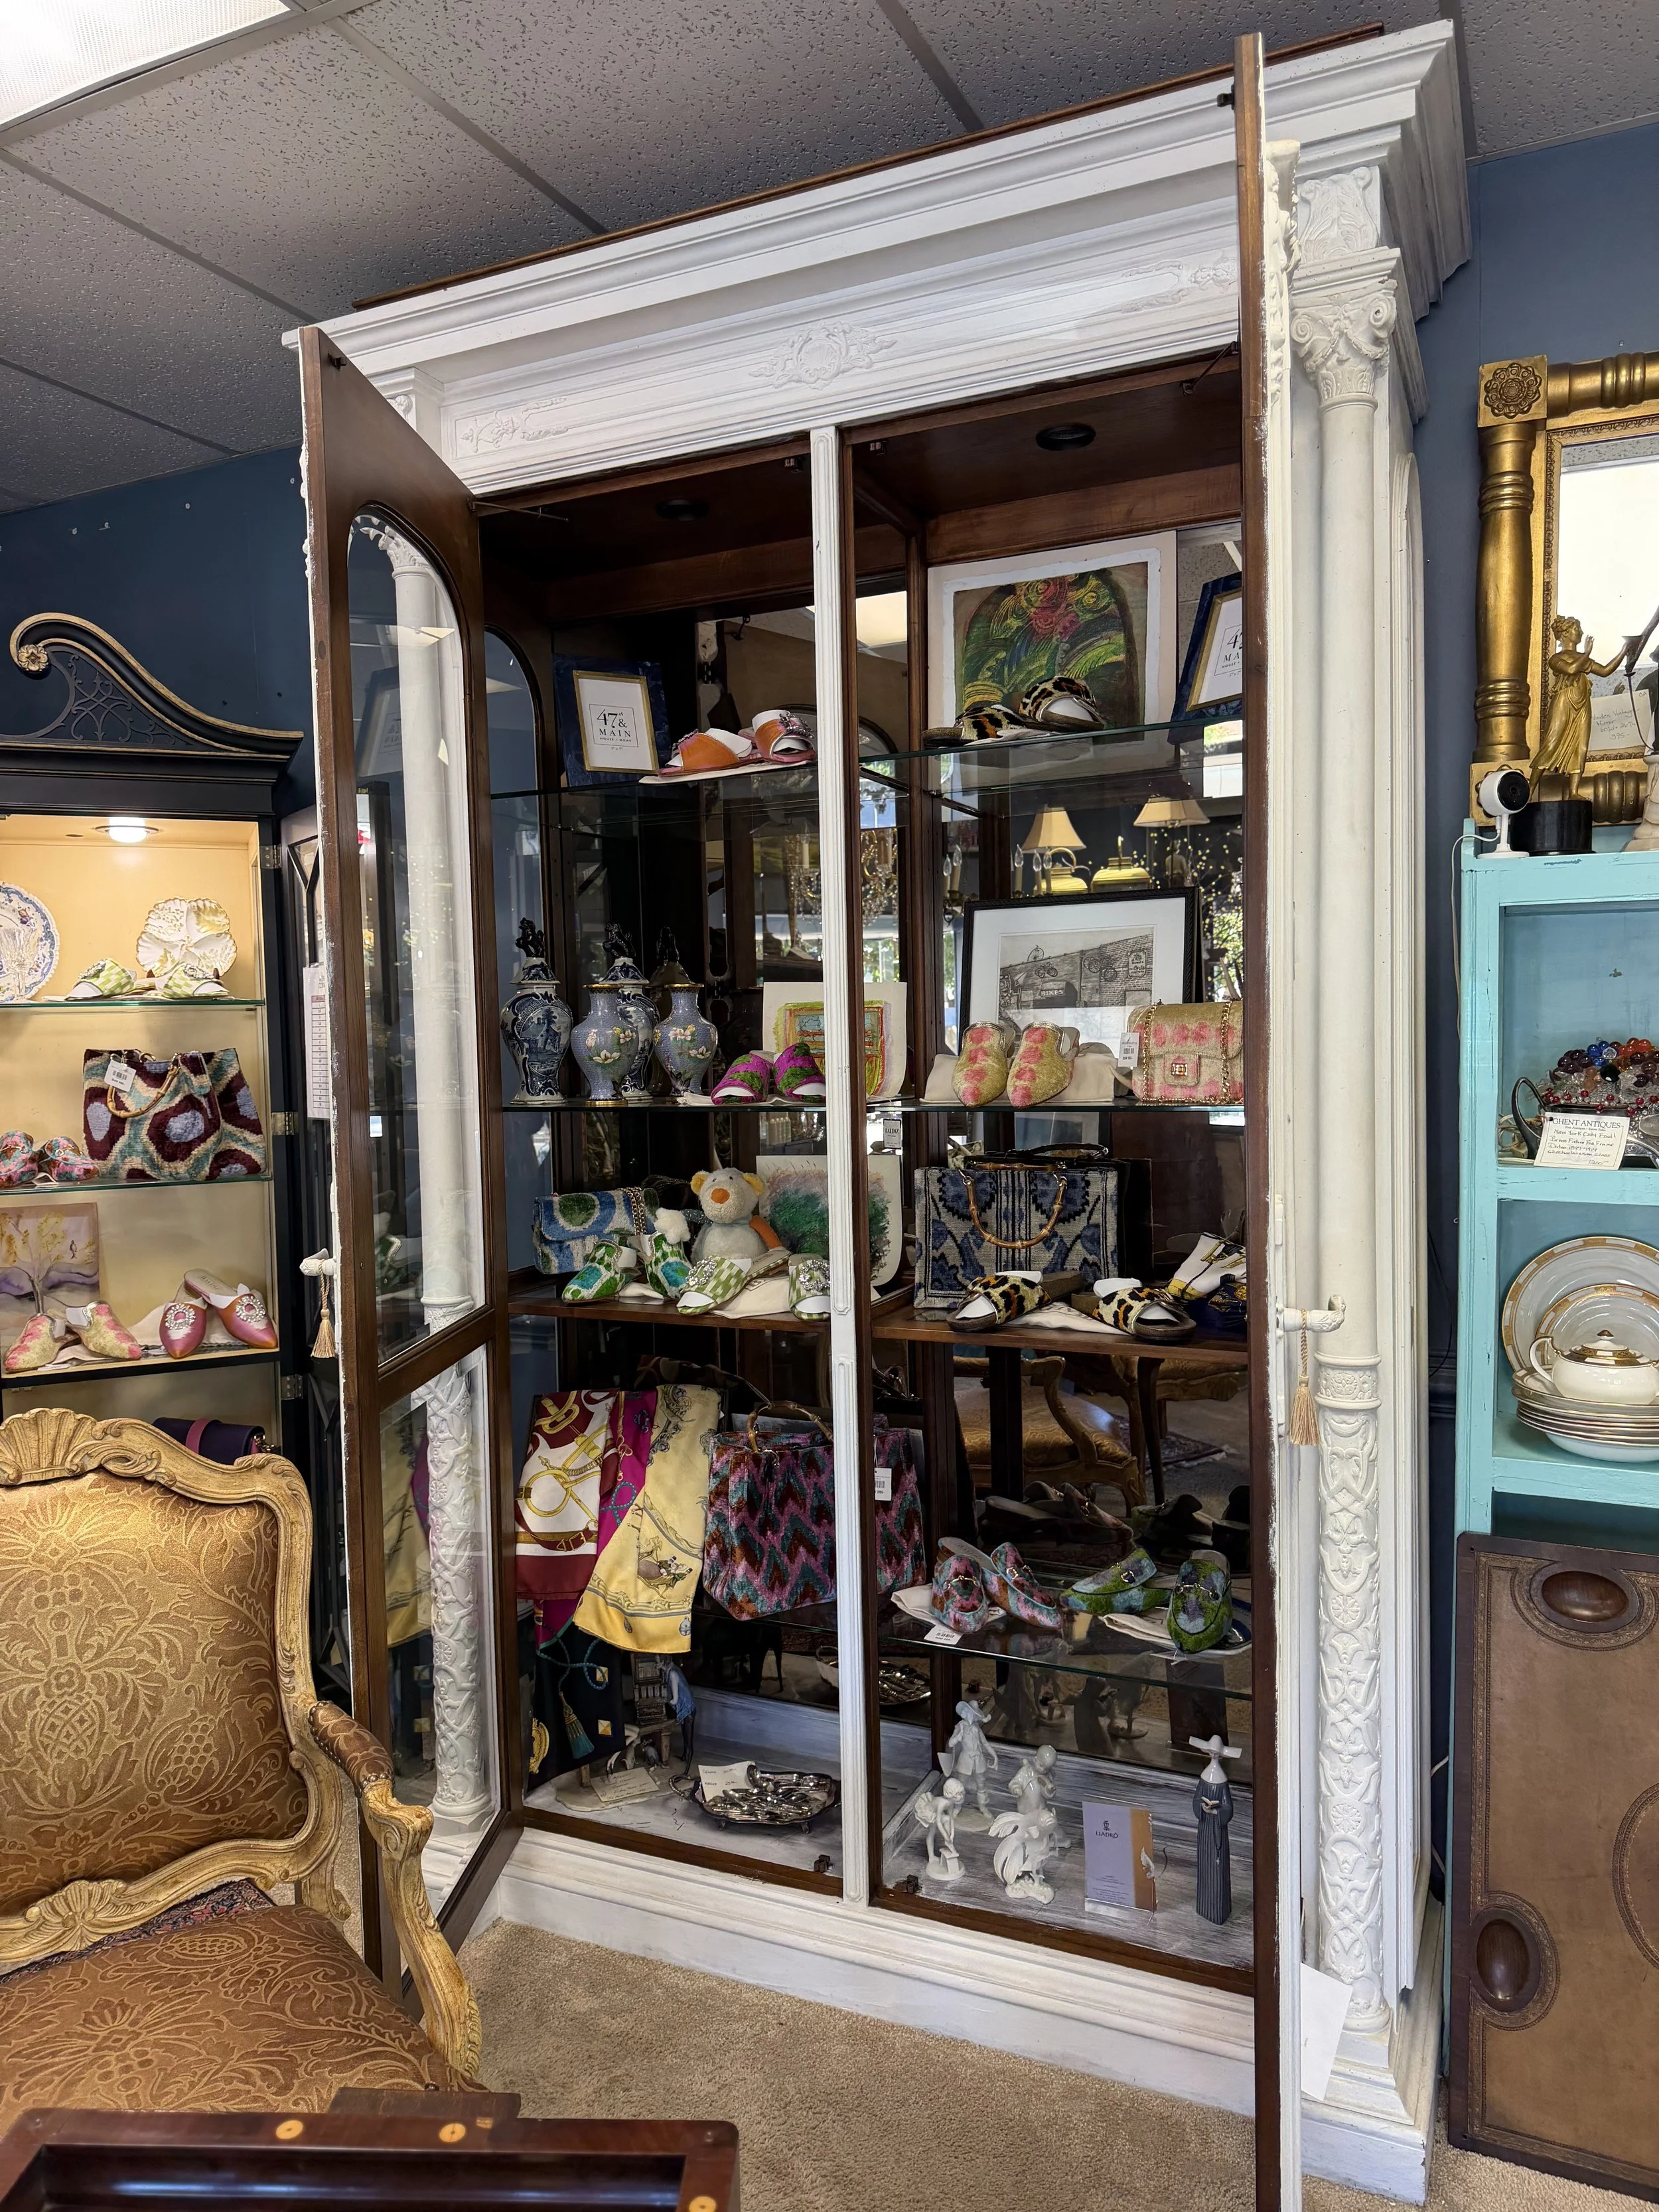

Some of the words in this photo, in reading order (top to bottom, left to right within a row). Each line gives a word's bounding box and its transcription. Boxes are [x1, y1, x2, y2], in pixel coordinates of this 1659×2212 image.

[618, 719, 628, 728] &
[599, 729, 631, 737] MAIN
[1580, 1120, 1621, 1129] ANTIQUES
